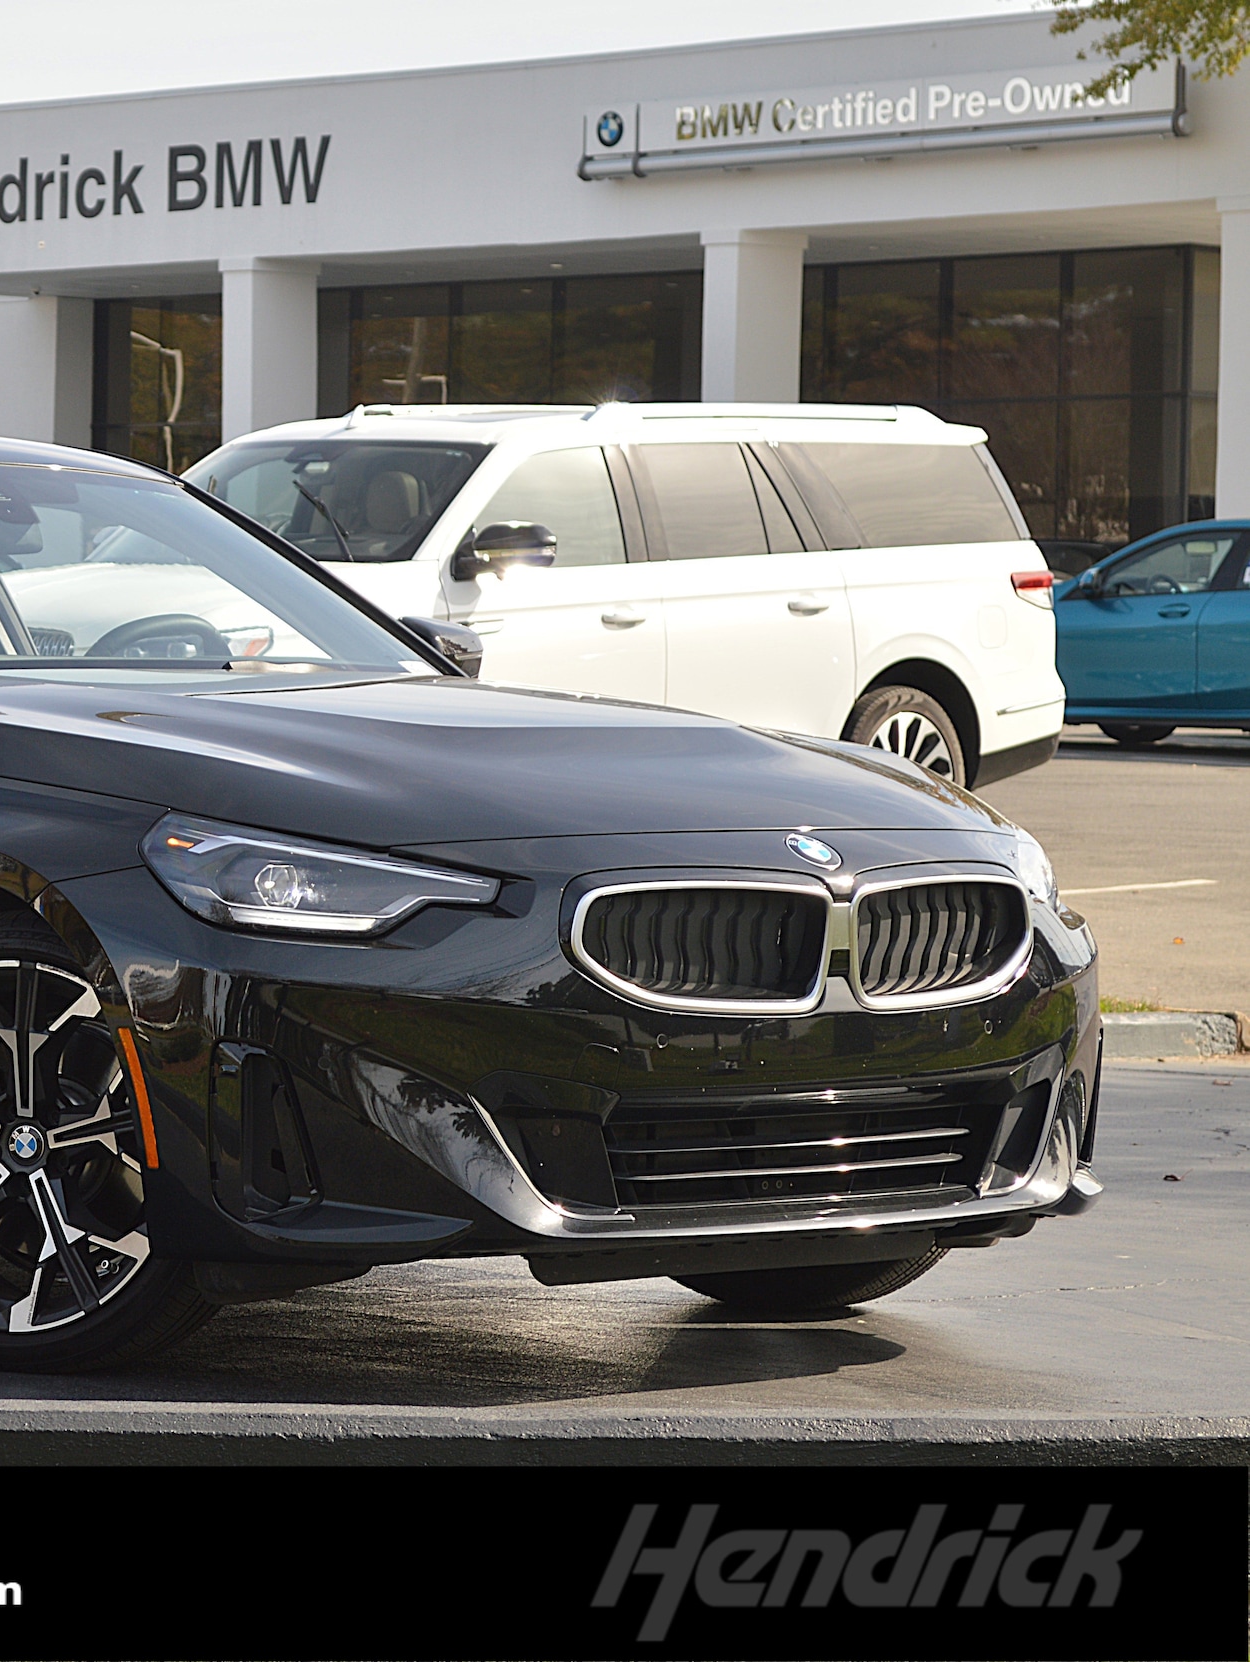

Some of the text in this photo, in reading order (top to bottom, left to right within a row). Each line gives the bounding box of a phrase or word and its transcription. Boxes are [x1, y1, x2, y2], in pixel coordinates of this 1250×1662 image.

[675, 102, 763, 140] BMW
[772, 87, 918, 133] Certified
[168, 135, 331, 212] BMW
